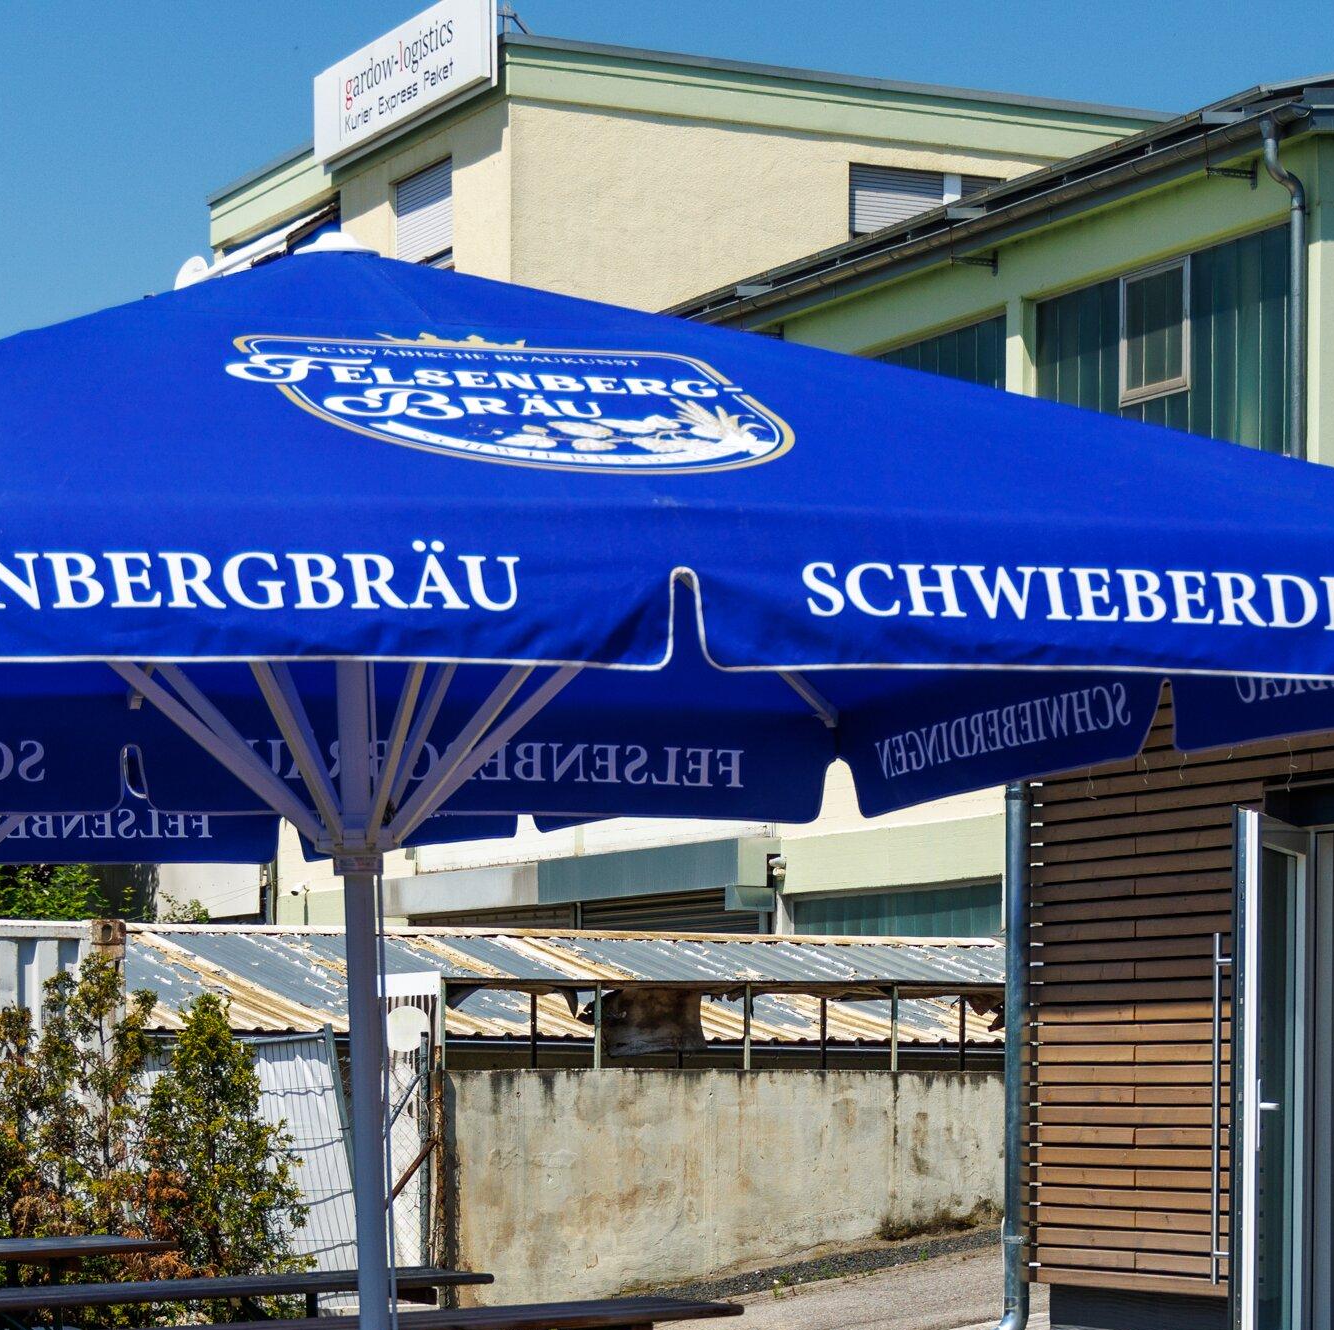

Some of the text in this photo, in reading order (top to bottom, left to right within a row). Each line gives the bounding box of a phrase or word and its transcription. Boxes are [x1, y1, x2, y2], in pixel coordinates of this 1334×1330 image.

[344, 18, 455, 111] gardow-logistics
[344, 57, 455, 133] Kurier Express Paket
[494, 354, 641, 367] BRAUKUNST
